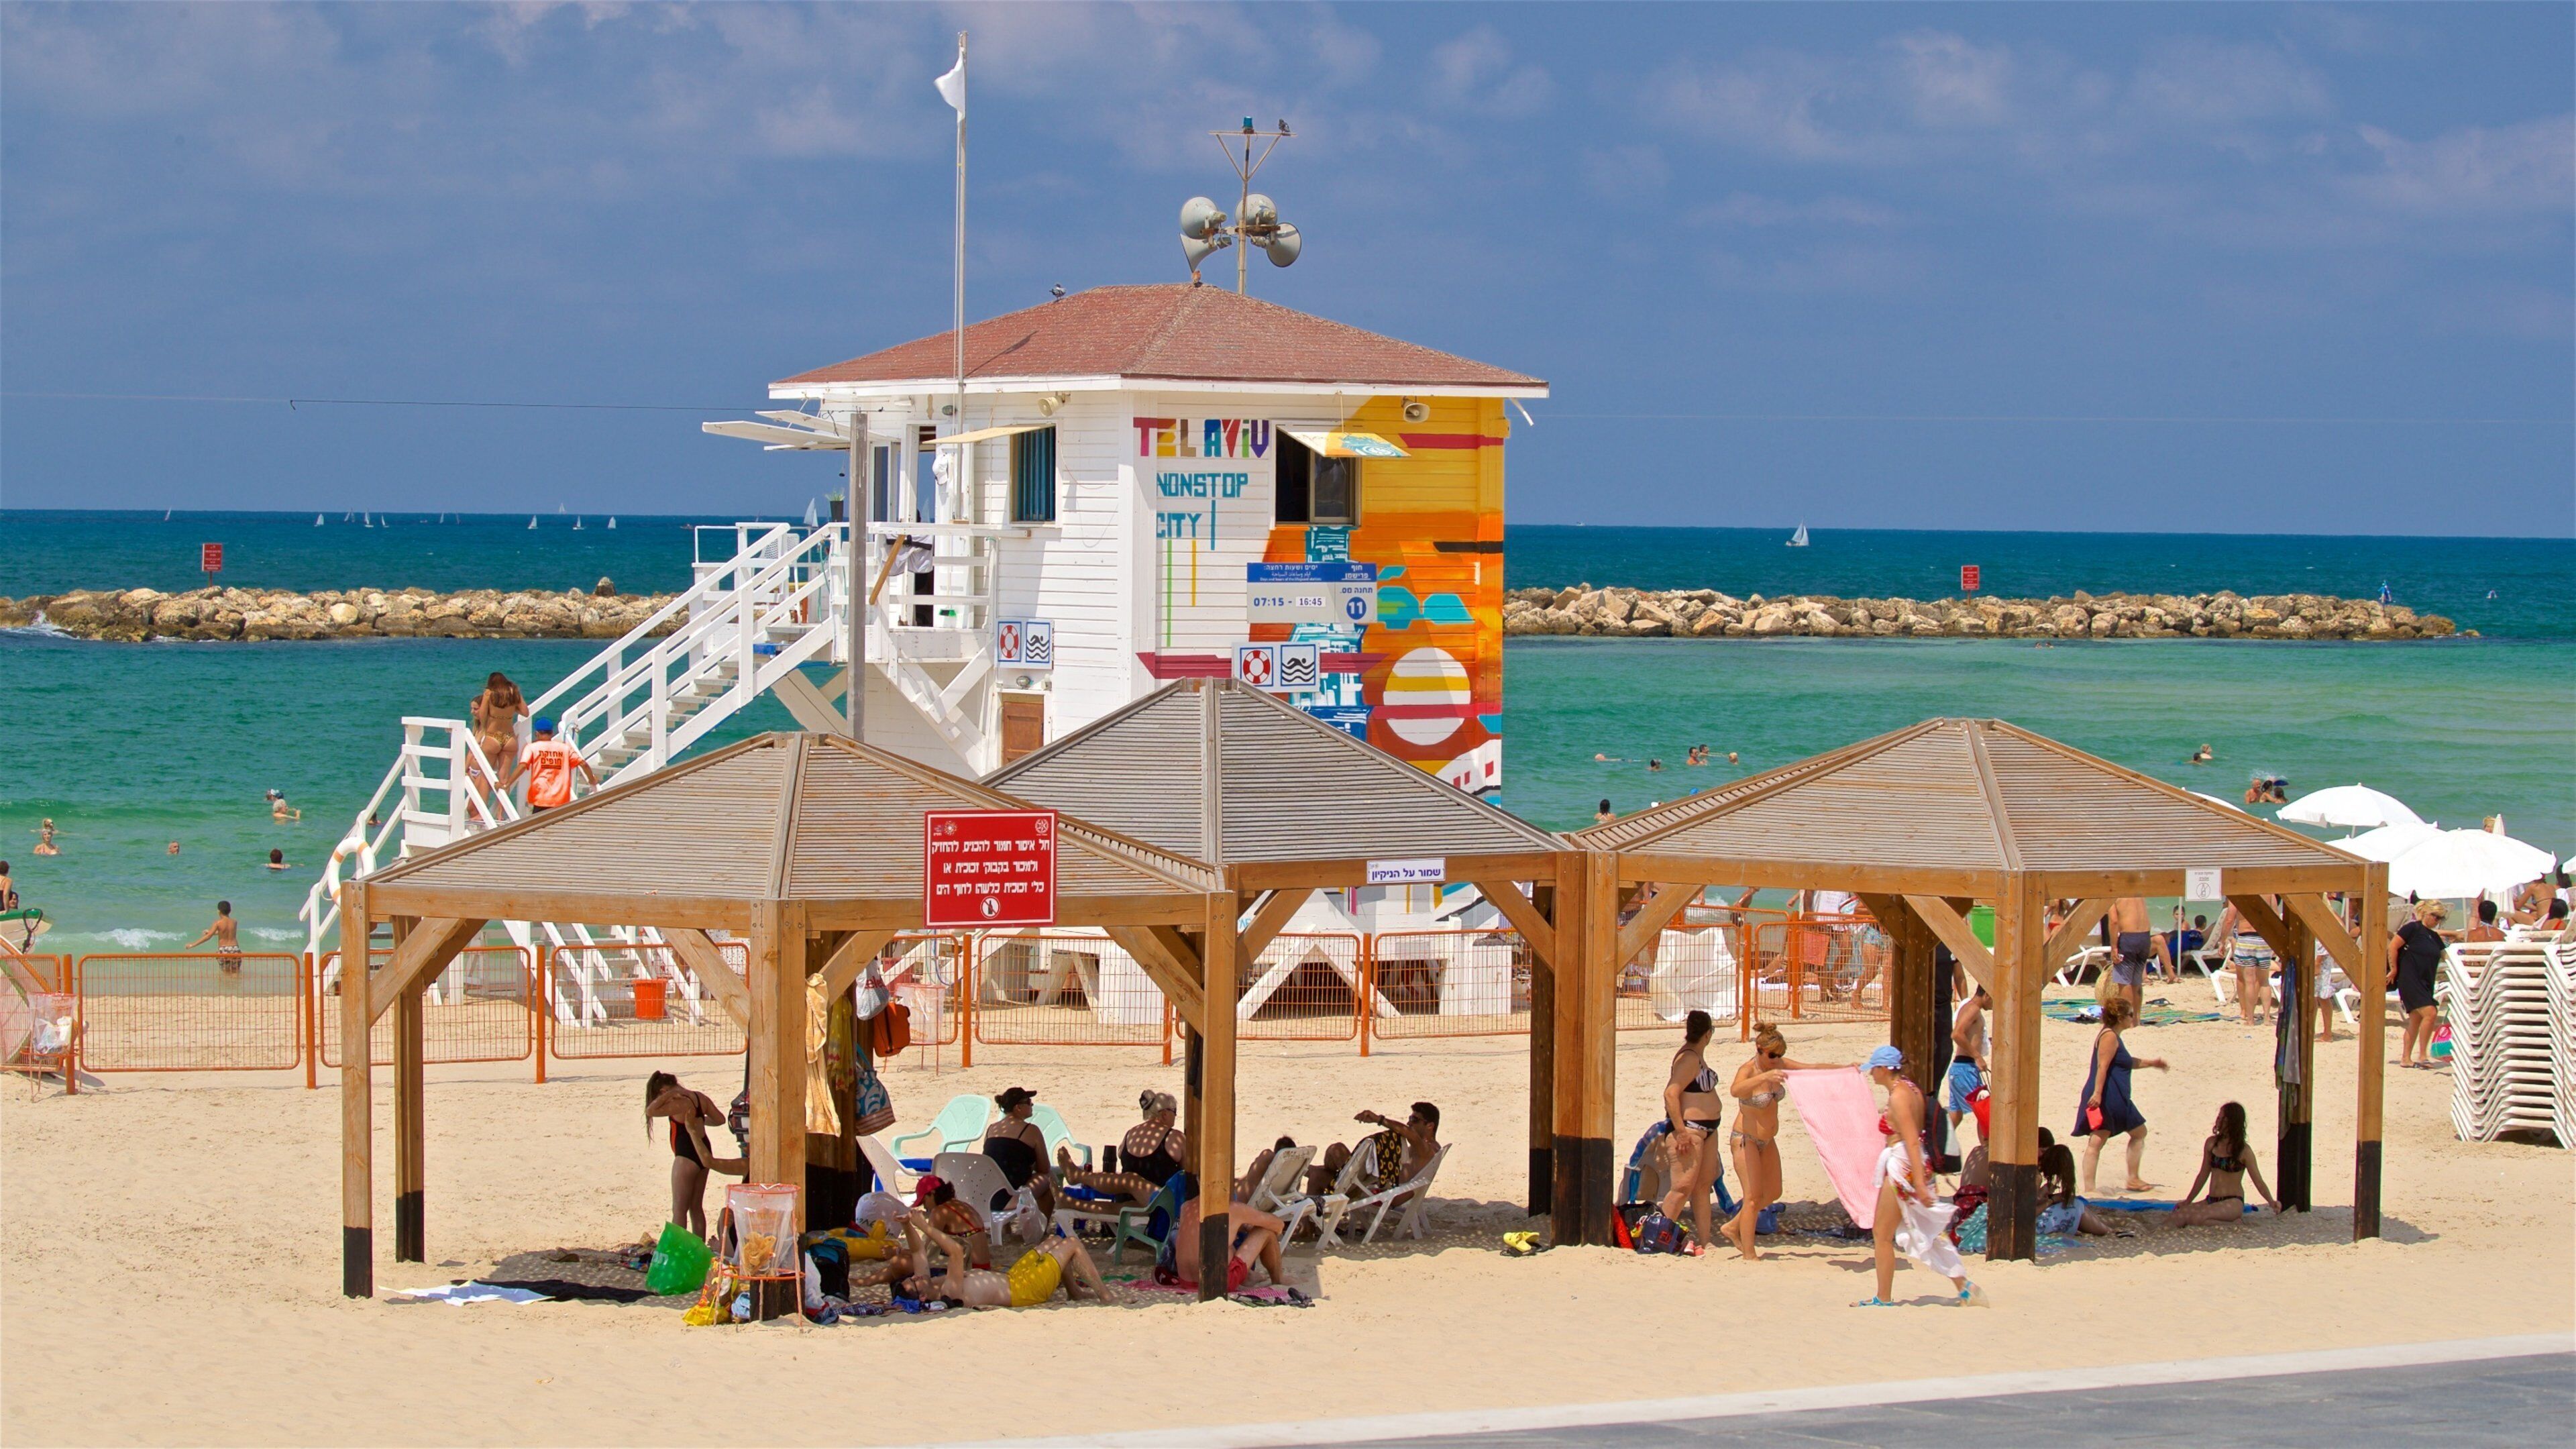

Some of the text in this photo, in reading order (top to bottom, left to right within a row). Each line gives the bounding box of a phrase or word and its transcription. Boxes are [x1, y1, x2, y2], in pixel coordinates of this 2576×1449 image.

[1133, 417, 1196, 457] TEL
[1157, 473, 1248, 498] NONSTOP
[1157, 513, 1202, 538] CITY
[1253, 597, 1284, 606] 07:15
[1299, 598, 1322, 606] 16:45
[1348, 602, 1363, 614] 11
[932, 840, 959, 854] להחזיק
[994, 841, 1012, 851] חמור
[1015, 839, 1035, 851] איסור
[1038, 839, 1050, 851] חל
[943, 860, 1038, 874] ולמכור בקבוקי זכוכית או
[1372, 868, 1441, 880] שמור על הניקיון
[936, 881, 1044, 896] כלי זכוכית כלשהו לחוף הים
